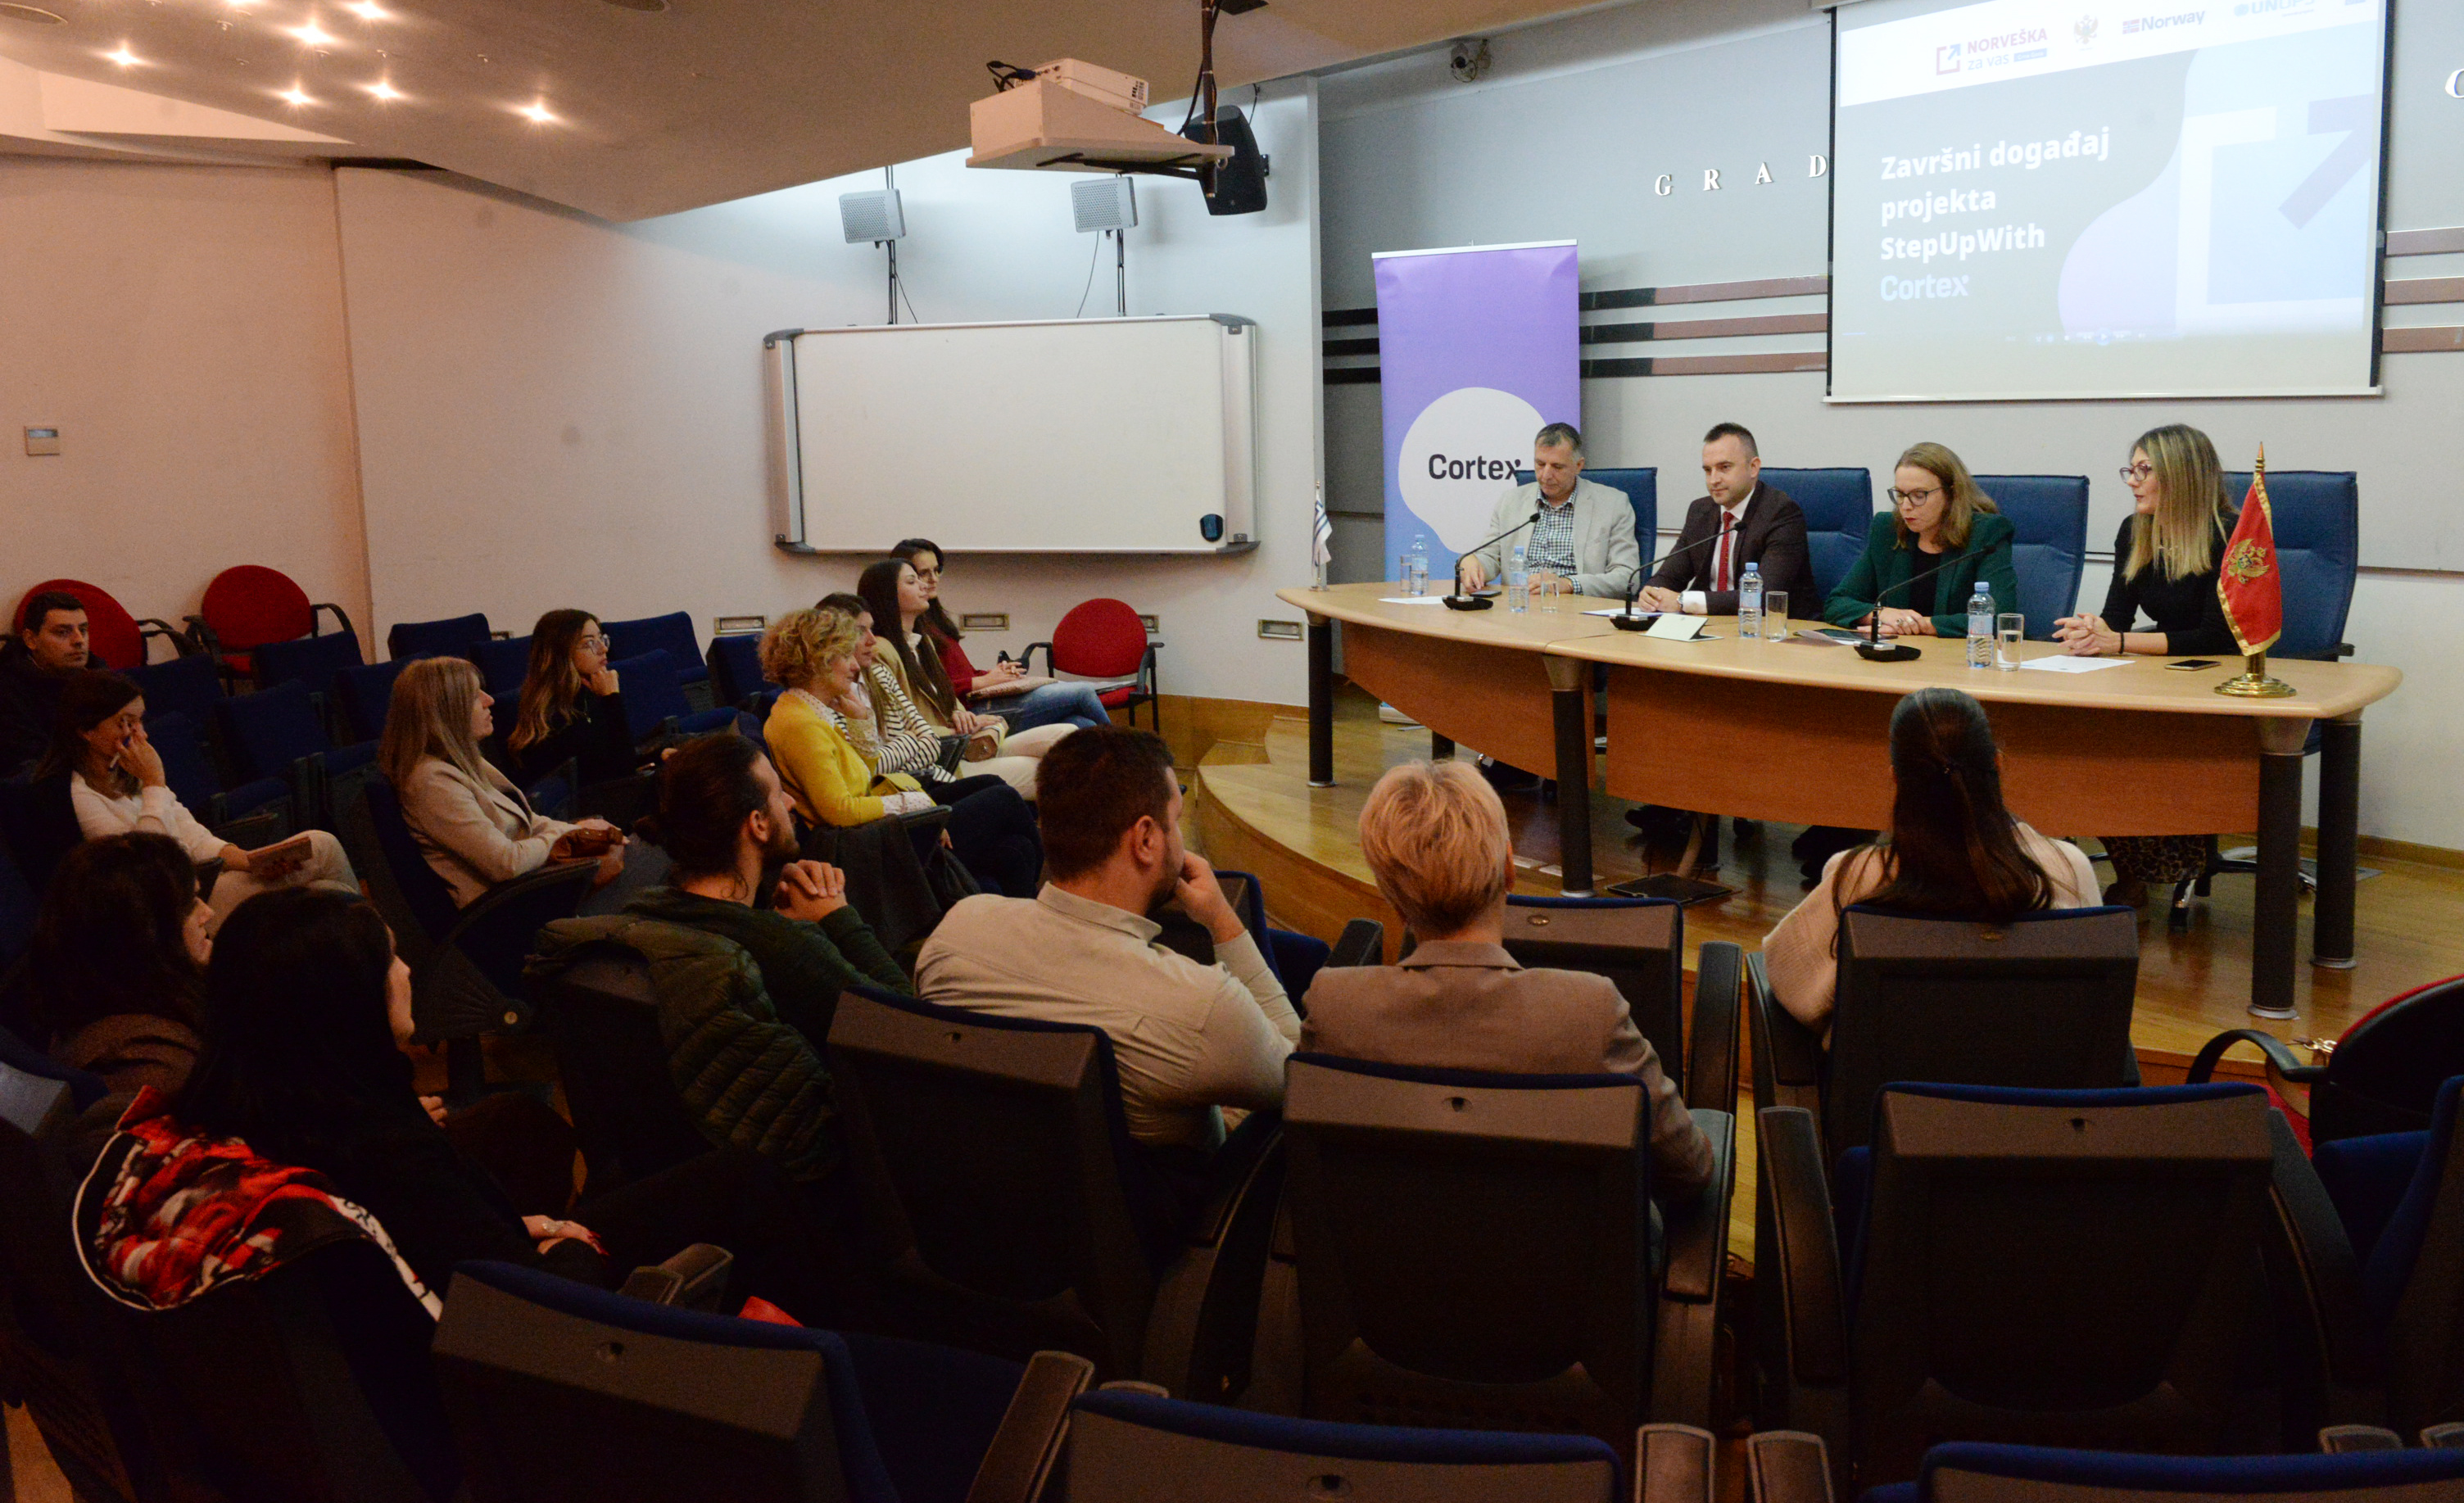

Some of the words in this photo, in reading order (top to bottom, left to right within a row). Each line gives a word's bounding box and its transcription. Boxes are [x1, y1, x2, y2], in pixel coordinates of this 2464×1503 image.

[2141, 10, 2205, 31] Norway
[1968, 28, 2048, 54] NORVEŠKA
[1968, 58, 1983, 70] za
[1986, 53, 2009, 67] vas
[1882, 144, 1981, 179] Završni
[1989, 126, 2109, 170] događaj
[1882, 188, 1996, 226] projekta
[1881, 223, 2045, 263] StepUpWith
[1881, 274, 1968, 301] Cortex
[1429, 454, 1521, 480] Cortex
